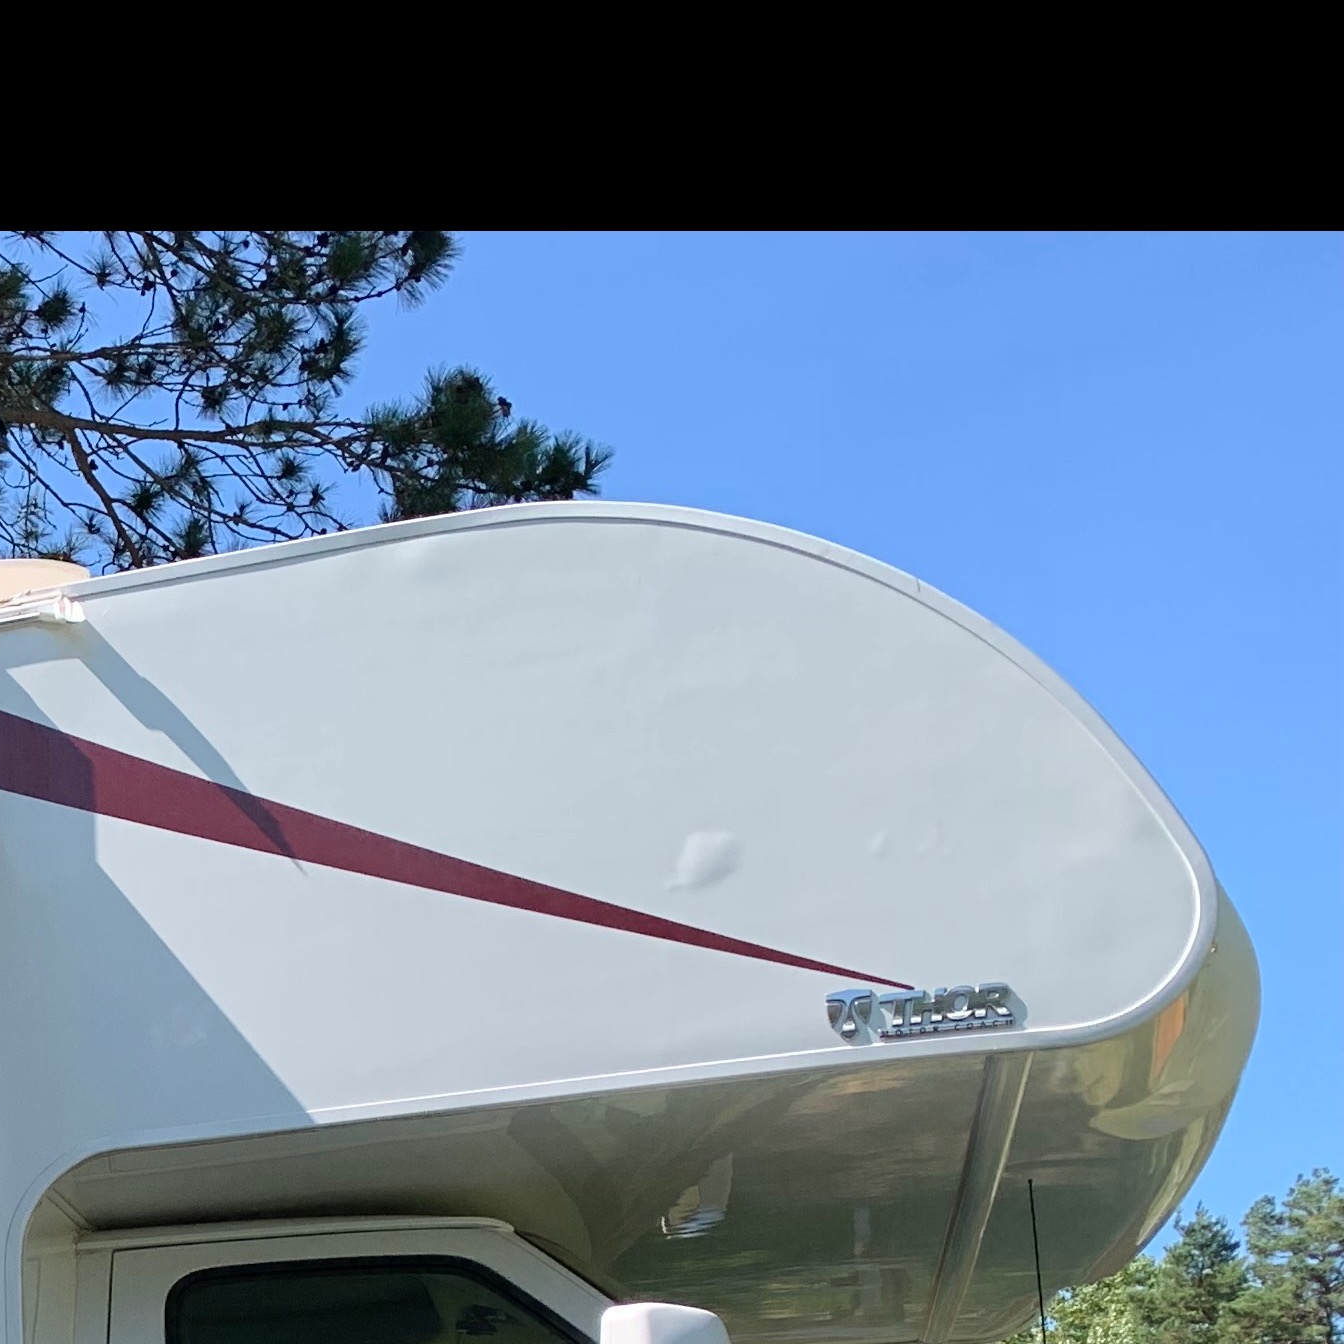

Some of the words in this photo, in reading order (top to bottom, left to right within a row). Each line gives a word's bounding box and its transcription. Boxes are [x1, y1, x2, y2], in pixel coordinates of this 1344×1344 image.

[879, 982, 1013, 1028] THOR
[879, 1025, 940, 1038] MOTOR
[954, 1018, 1014, 1032] COACH
